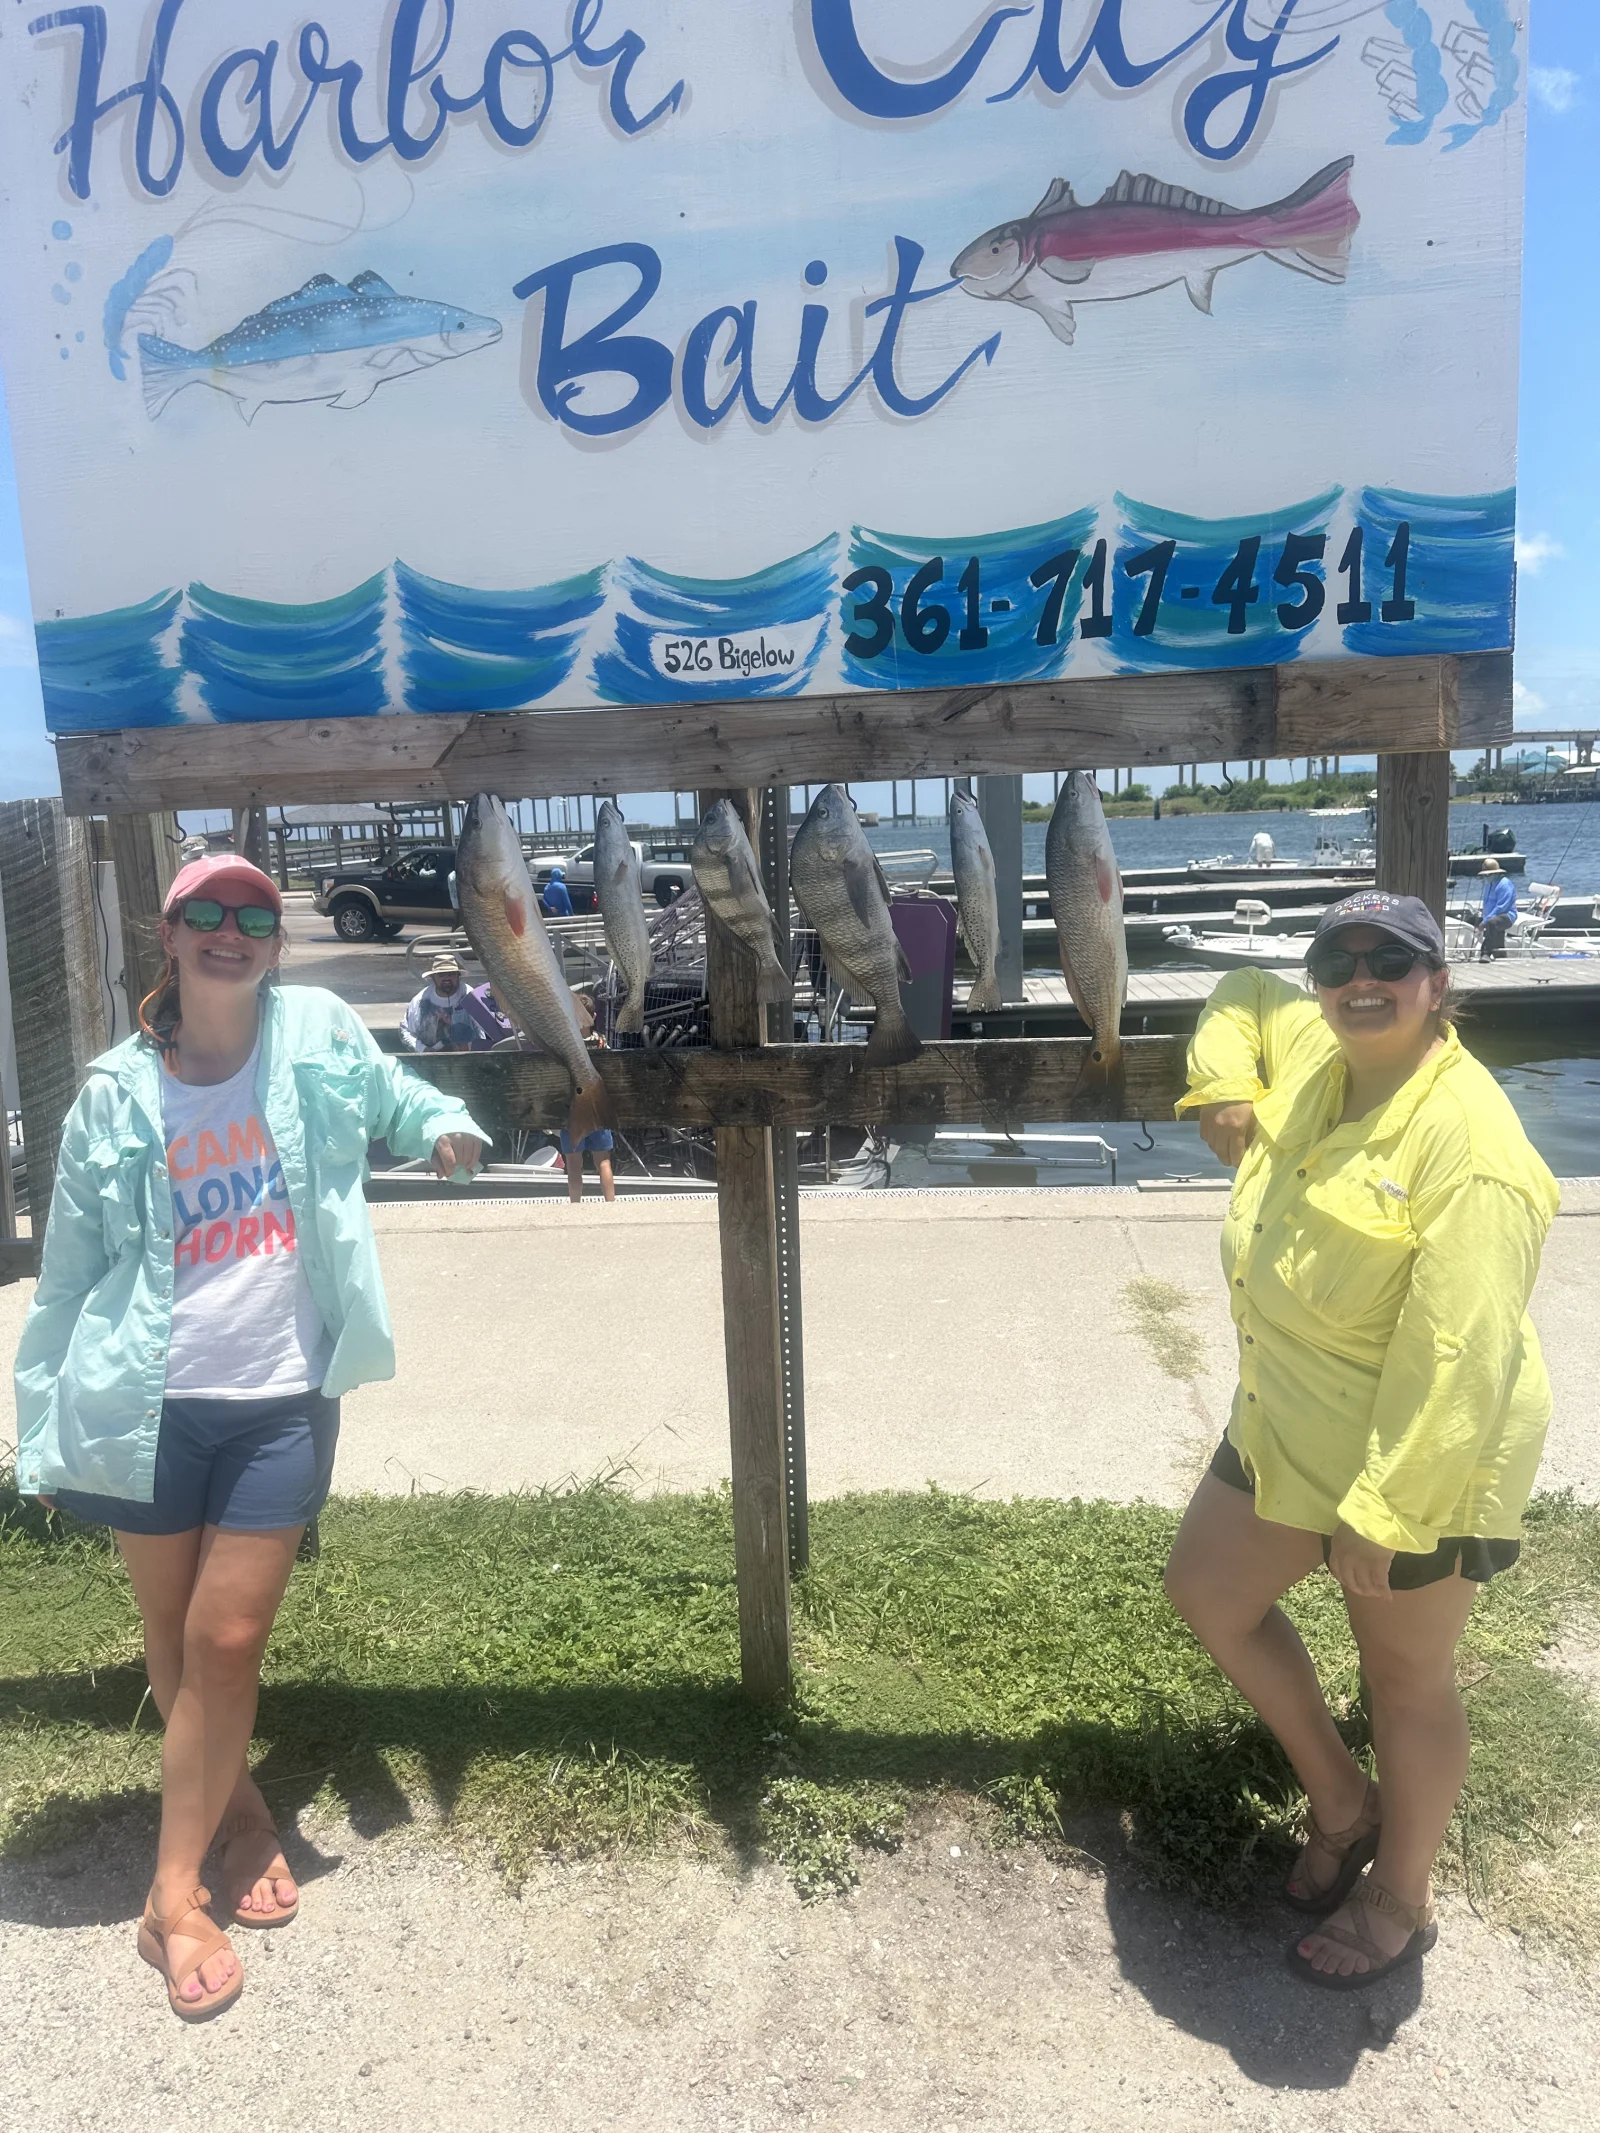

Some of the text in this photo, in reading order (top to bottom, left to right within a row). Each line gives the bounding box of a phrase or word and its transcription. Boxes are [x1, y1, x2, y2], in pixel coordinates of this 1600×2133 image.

[28, 0, 686, 200] Harbor
[512, 235, 1002, 436] Bait
[842, 521, 1415, 659] 361-717-4511
[664, 635, 796, 677] 526 Bigelow
[1334, 893, 1400, 912] DOCKERS
[166, 1114, 278, 1182] CAM
[173, 1207, 297, 1268] HORN
